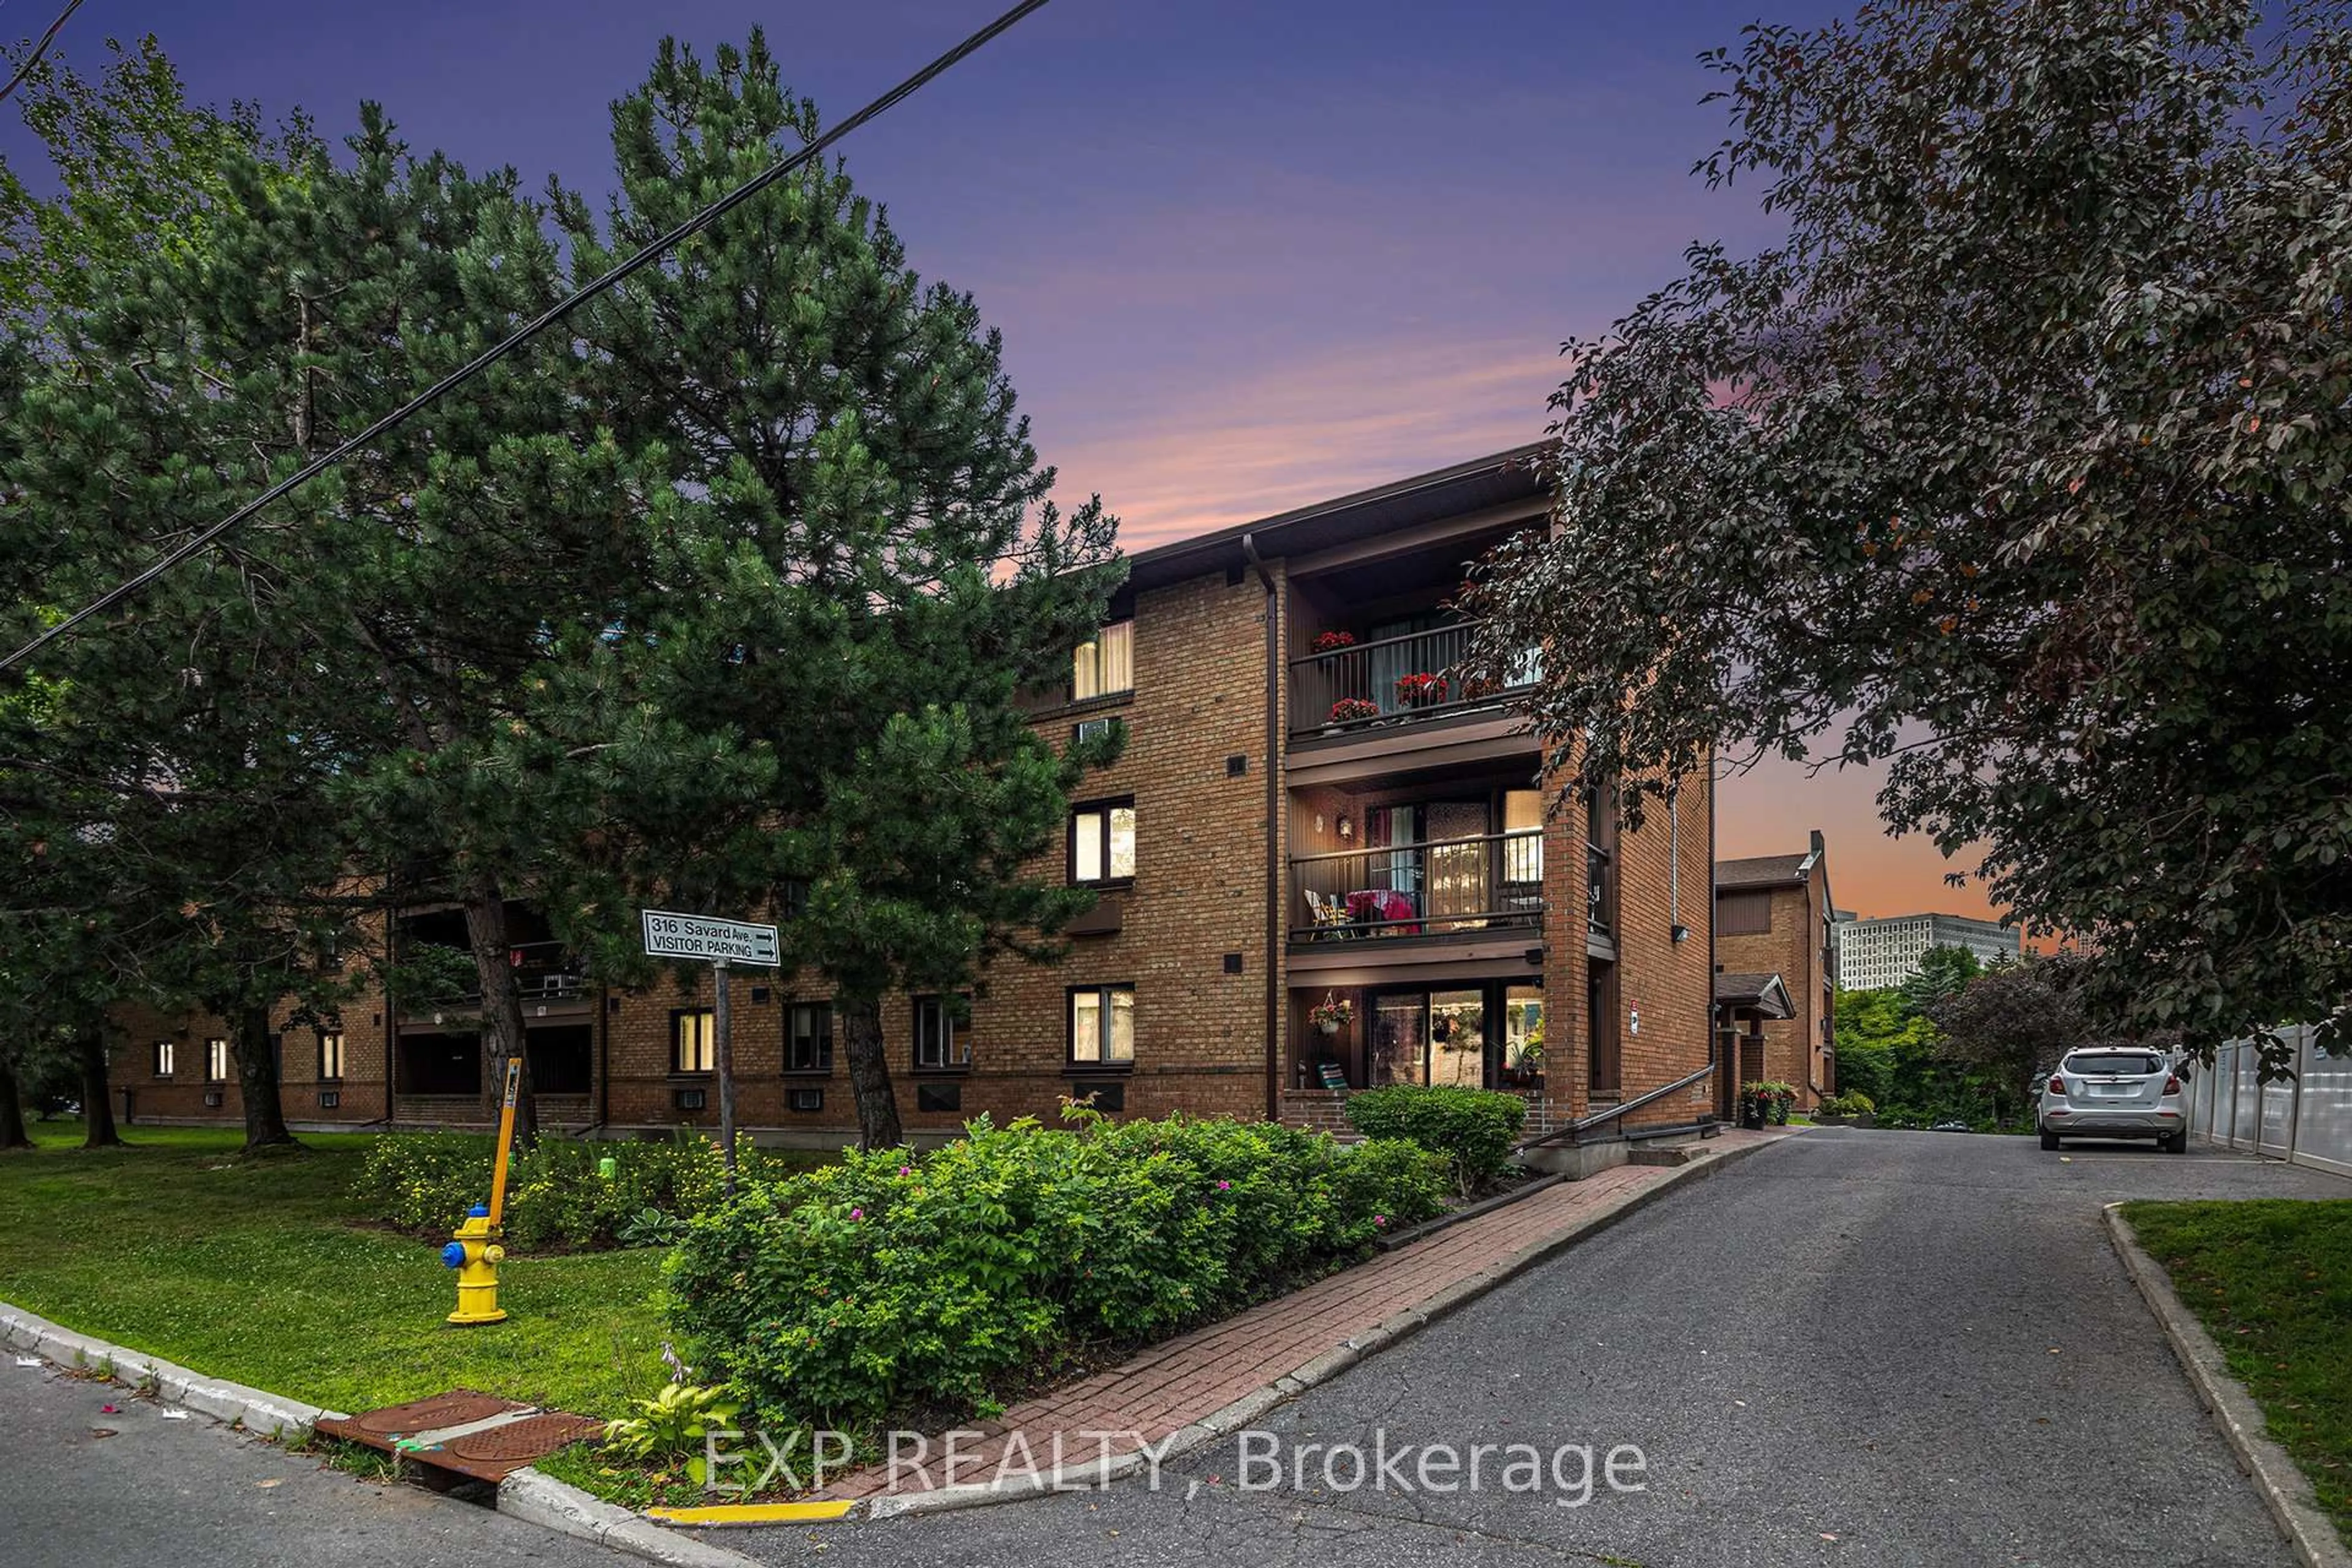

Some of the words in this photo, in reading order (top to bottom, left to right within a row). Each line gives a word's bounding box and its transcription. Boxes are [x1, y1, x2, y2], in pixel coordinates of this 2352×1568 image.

[652, 918, 678, 933] 316
[685, 921, 730, 939] Savard
[733, 929, 752, 943] Ave.
[653, 936, 703, 952] VISITOR
[707, 941, 752, 957] PARKING
